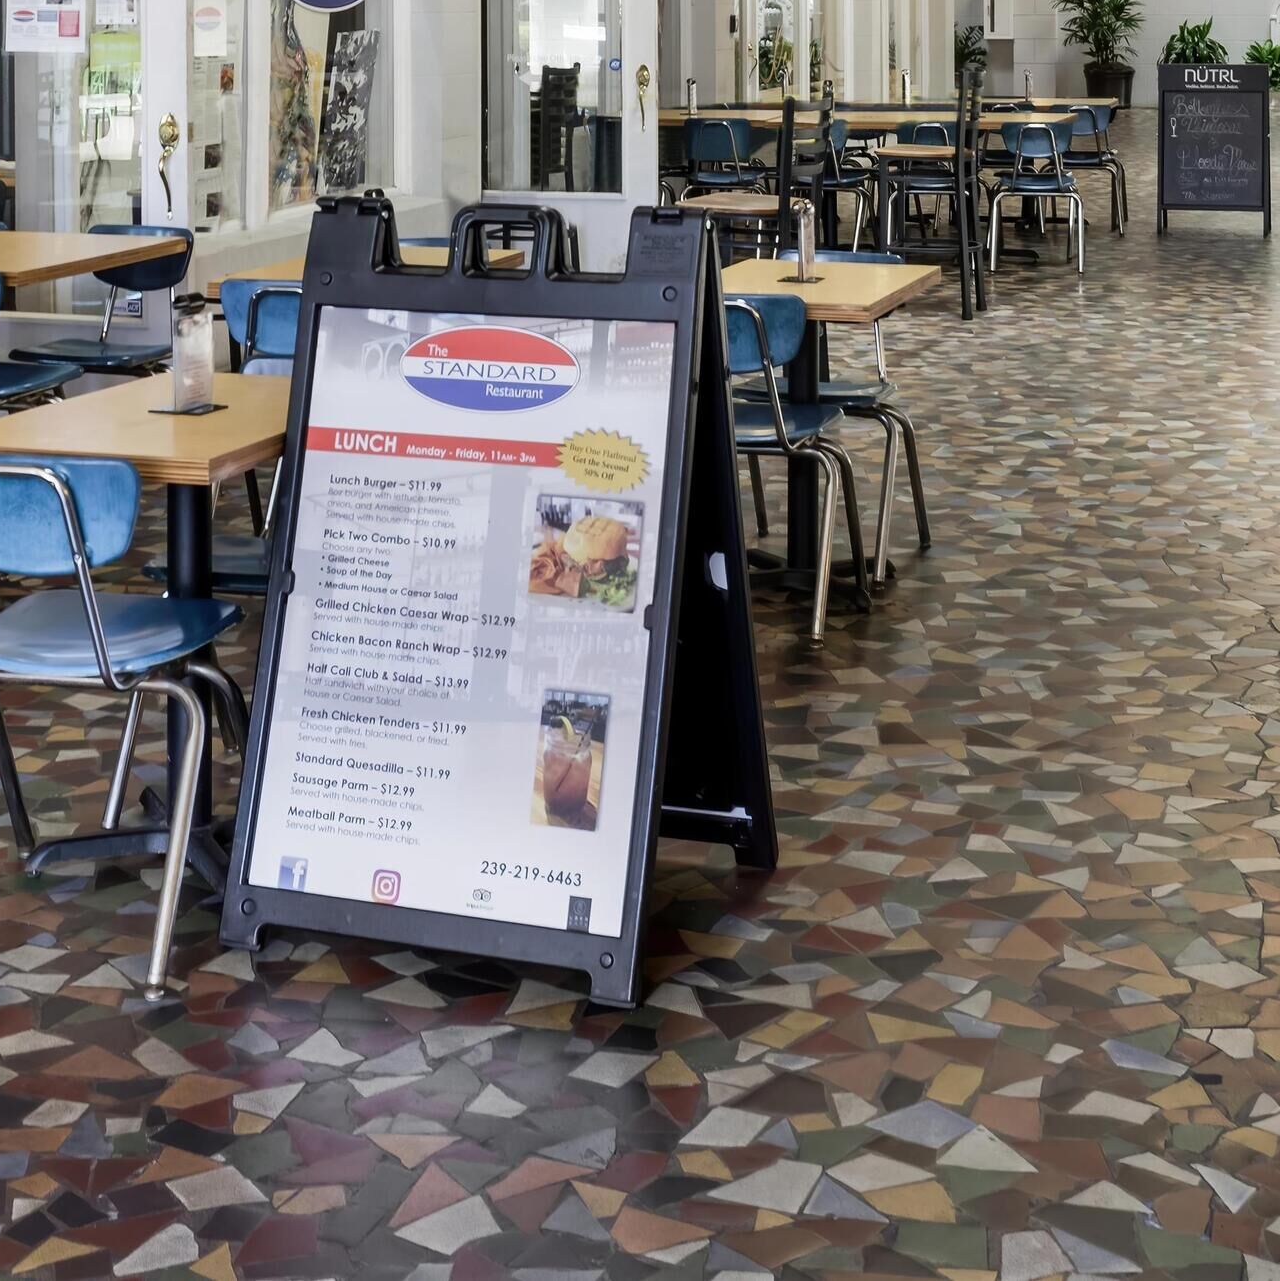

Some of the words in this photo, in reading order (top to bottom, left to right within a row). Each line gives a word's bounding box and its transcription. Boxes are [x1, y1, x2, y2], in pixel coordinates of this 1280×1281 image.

[428, 343, 448, 357] The
[423, 360, 556, 383] STANDARD
[486, 383, 543, 400] Restaurant
[334, 431, 397, 453] LUNCH
[407, 445, 447, 459] Monday
[456, 448, 487, 462] Friday,
[570, 443, 584, 452] Buy
[586, 446, 600, 455] One
[603, 450, 636, 462] Flatbread
[573, 455, 586, 464] Get
[588, 458, 600, 466] the
[603, 460, 629, 472] Second
[584, 468, 599, 477] 50%
[330, 474, 360, 486] Lunch
[364, 477, 396, 490] Burger
[408, 480, 442, 492] $11.99
[345, 488, 372, 499] burger
[375, 491, 391, 500] with
[355, 502, 372, 511] and
[375, 503, 415, 514] American
[326, 510, 355, 519] Served
[357, 512, 373, 521] with
[376, 515, 429, 526] house-made
[322, 542, 355, 552] Choose
[357, 546, 372, 555] any
[324, 529, 345, 540] Pick
[348, 531, 367, 542] Two
[371, 533, 410, 545] Combo
[422, 537, 456, 549] $10.99
[328, 554, 355, 564] Grilled
[358, 558, 390, 567] Cheese
[327, 566, 347, 577] Soup
[350, 568, 358, 577] of
[360, 569, 373, 578] the
[376, 571, 392, 581] Day
[324, 582, 359, 591] Medium
[361, 585, 387, 594] House
[401, 588, 431, 598] Caesar
[434, 591, 458, 601] Salad
[314, 612, 343, 622] Served
[345, 615, 361, 624] with
[363, 617, 418, 631] house-made
[316, 598, 349, 611] Grilled
[352, 602, 397, 616] Chicken
[400, 607, 438, 620] Caesar
[441, 611, 469, 623] Wrap
[481, 614, 516, 627] $12.99
[309, 644, 339, 655] Served
[341, 647, 358, 657] with
[360, 649, 415, 663] house-made
[311, 631, 355, 644] Chicken
[359, 635, 392, 648] Bacon
[396, 639, 429, 651] Ranch
[433, 643, 460, 656] Wrap
[472, 647, 507, 660] $12.99
[307, 662, 328, 674] Half
[355, 668, 379, 680] Club
[382, 672, 388, 680] &
[392, 673, 422, 685] Salad
[435, 677, 469, 689] $13.99
[304, 689, 330, 699] House
[343, 693, 373, 704] Caesar
[305, 676, 322, 686] Half
[324, 679, 365, 692] sandwich
[367, 682, 384, 693] with
[385, 687, 405, 697] your
[408, 687, 437, 698] choice
[440, 690, 450, 700] of
[301, 707, 328, 719] Fresh
[331, 711, 376, 725] Chicken
[379, 716, 420, 730] Tenders
[432, 722, 467, 735] $11.99
[298, 733, 327, 744] Served
[329, 736, 347, 746] with
[299, 720, 332, 732] Choose
[416, 735, 426, 743] or
[295, 752, 343, 767] Standard
[347, 758, 404, 775] Quesadilla
[416, 766, 451, 780] $11.99
[292, 772, 338, 789] Sausage
[342, 779, 369, 791] Parm
[380, 783, 415, 797] $12.99
[290, 787, 320, 798] Served
[322, 790, 340, 801] with
[342, 794, 398, 808] house-made
[400, 801, 424, 812] chips.
[288, 806, 335, 822] Meatball
[338, 813, 366, 825] Parm
[378, 818, 412, 831] $12.99
[286, 820, 316, 832] Served
[318, 824, 336, 834] with
[338, 827, 393, 842] house-made
[395, 835, 421, 846] chips.
[480, 860, 582, 886] 239-219-6463
